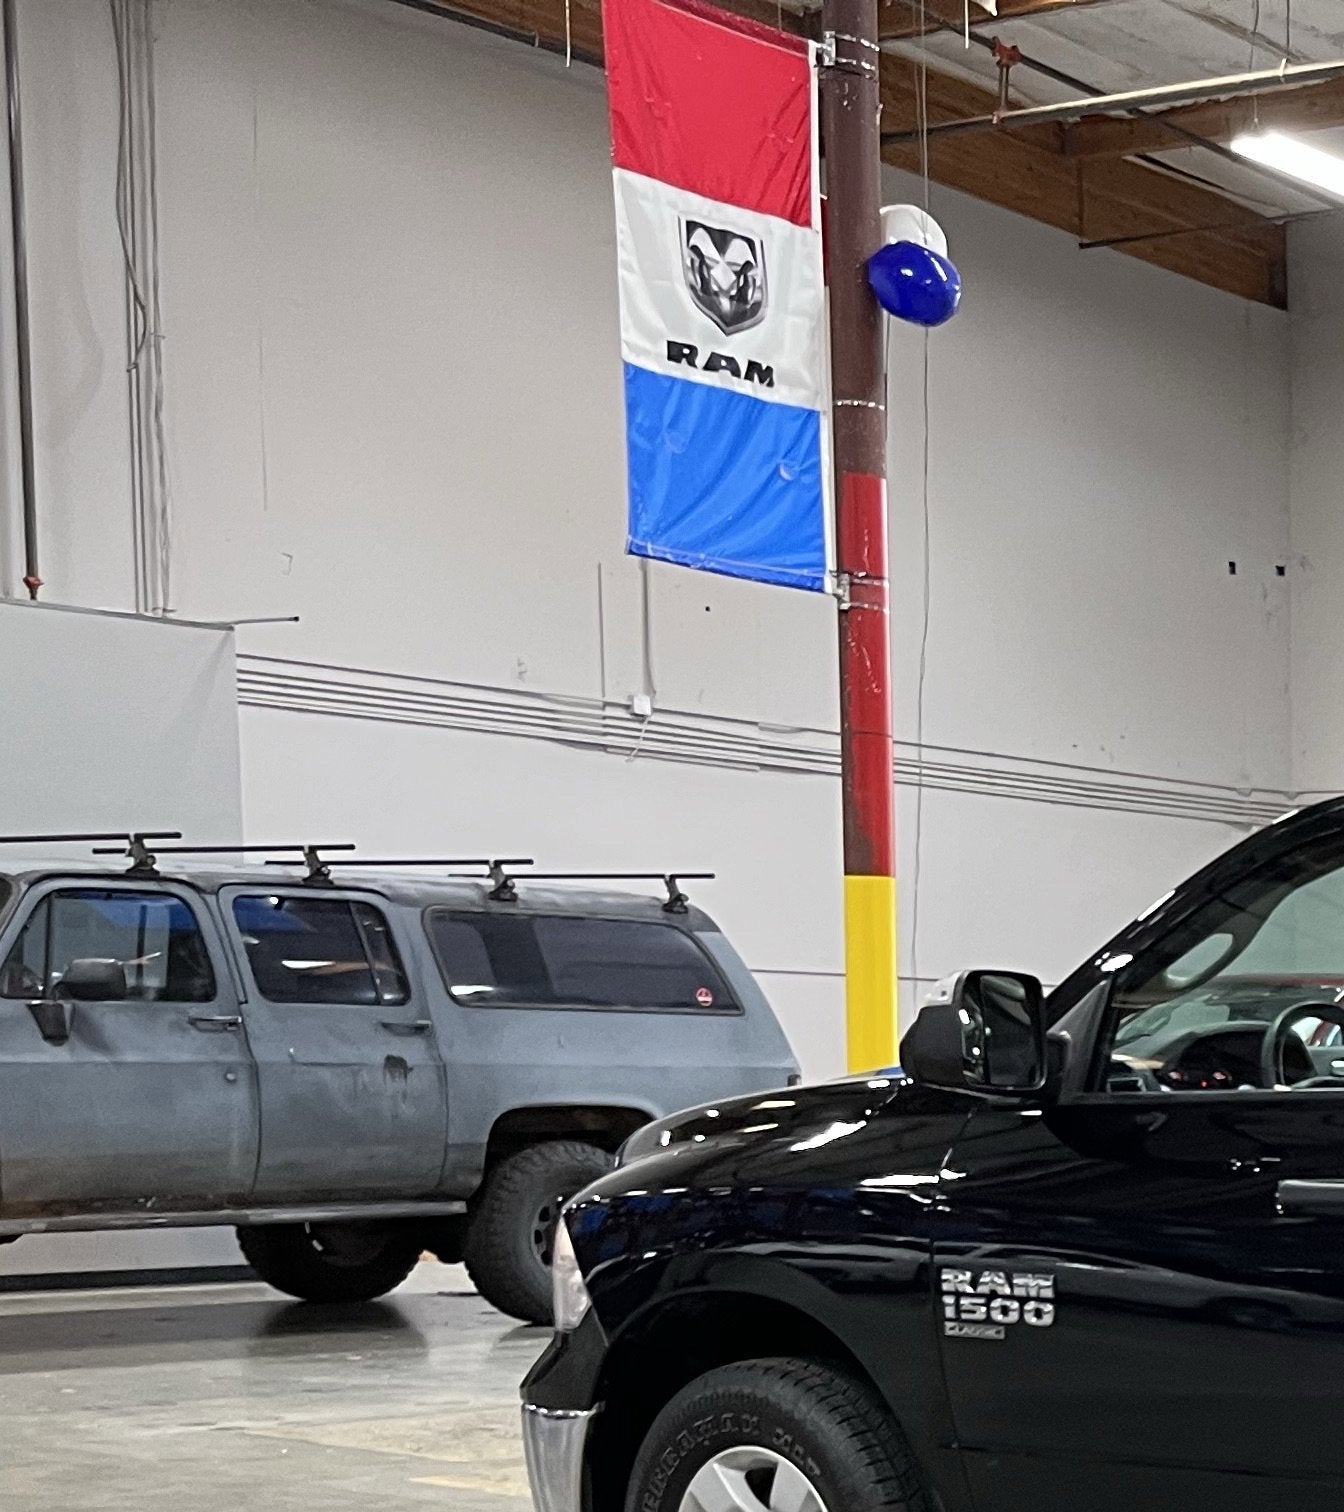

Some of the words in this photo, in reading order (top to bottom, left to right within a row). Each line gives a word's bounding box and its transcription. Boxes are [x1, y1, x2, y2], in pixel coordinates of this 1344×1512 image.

[666, 339, 774, 389] RAM
[941, 1268, 1055, 1299] RAM
[942, 1294, 1055, 1327] 1500
